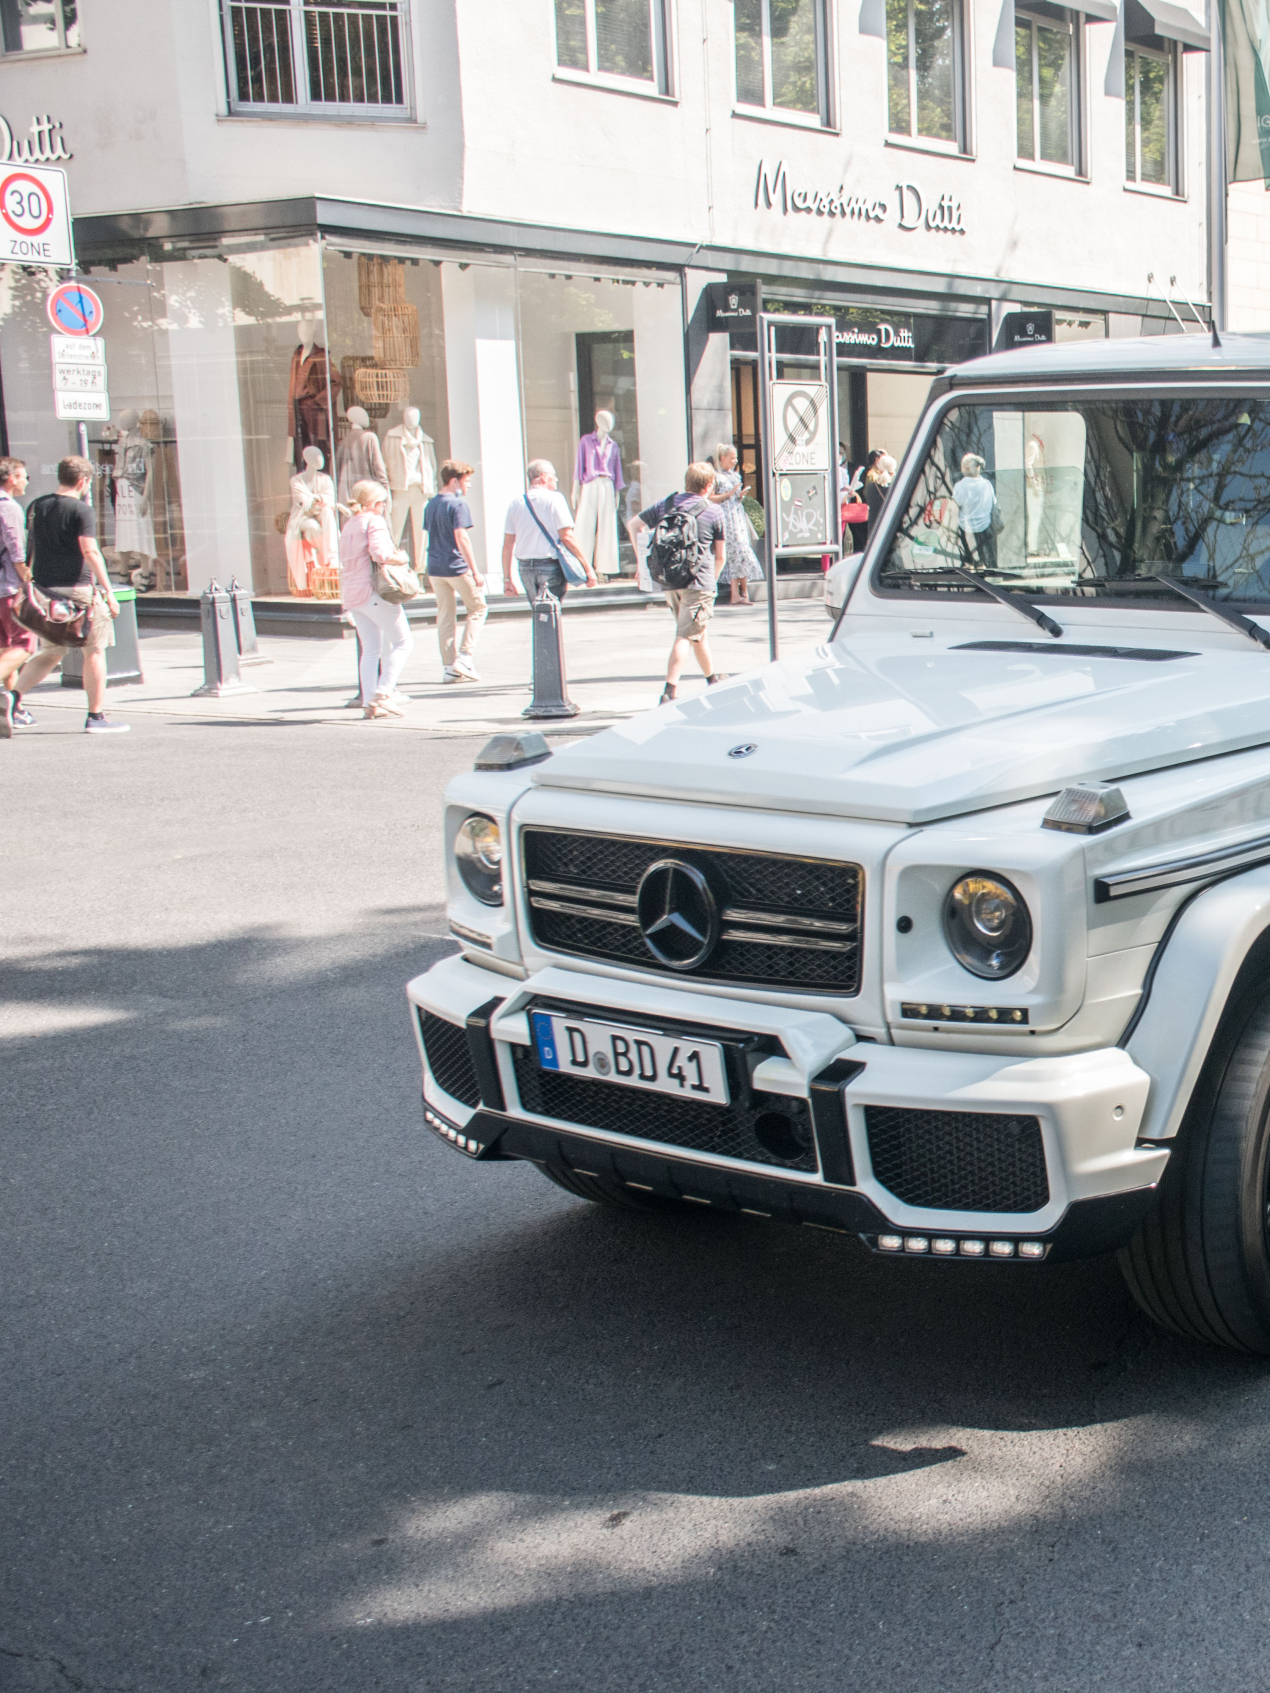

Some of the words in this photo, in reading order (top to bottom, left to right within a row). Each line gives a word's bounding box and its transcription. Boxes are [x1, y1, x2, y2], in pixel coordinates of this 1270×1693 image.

[10, 189, 42, 219] 30
[753, 158, 890, 224] Massimo
[895, 181, 967, 236] Dutti
[10, 239, 52, 257] ZONE
[877, 323, 915, 348] Dutti
[79, 343, 92, 351] dem
[58, 367, 102, 379] werktags
[80, 378, 88, 388] 19
[63, 399, 103, 411] Ladezone
[544, 1046, 553, 1059] D
[565, 1025, 590, 1068] D
[611, 1033, 659, 1083] BD
[667, 1046, 711, 1094] 41
